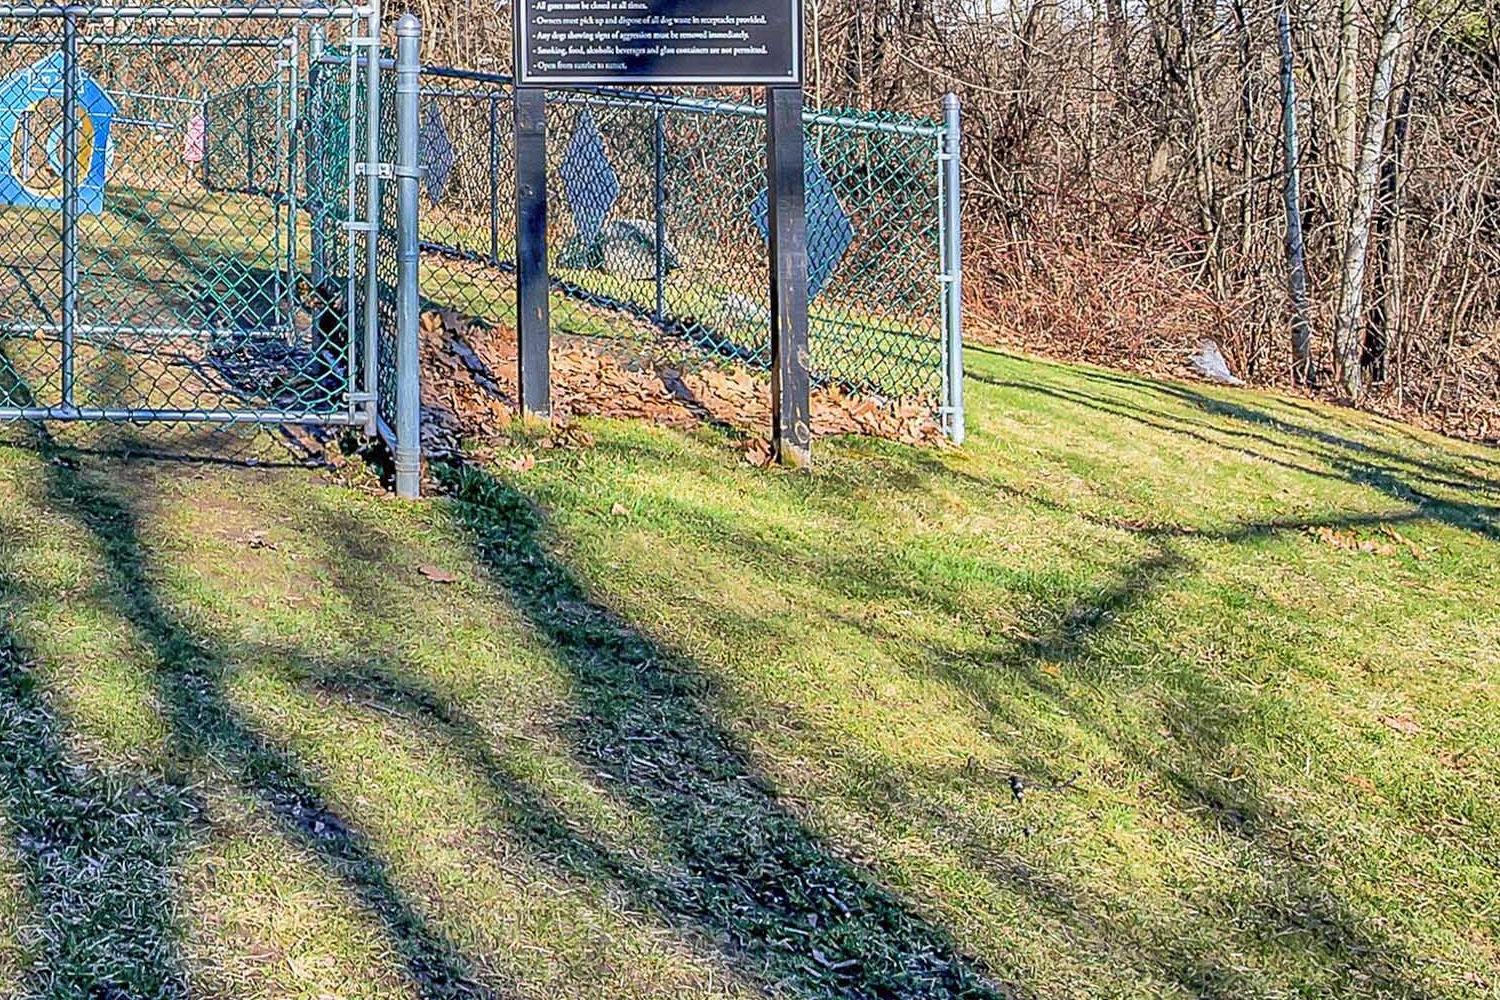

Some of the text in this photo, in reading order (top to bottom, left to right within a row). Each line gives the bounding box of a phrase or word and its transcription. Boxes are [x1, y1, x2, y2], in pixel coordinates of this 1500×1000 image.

[536, 1, 546, 10] All
[581, 1, 589, 10] be
[590, 1, 610, 10] closed
[618, 1, 627, 9] all
[627, 1, 648, 10] times.
[536, 16, 562, 25] Owners
[562, 17, 579, 25] must
[579, 16, 594, 26] pick
[595, 18, 604, 26] up
[605, 16, 617, 24] and
[618, 16, 642, 26] dispose
[642, 15, 651, 24] of
[651, 16, 659, 24] all
[660, 15, 673, 26] dog
[692, 15, 700, 24] in
[700, 15, 735, 26] receptacles
[735, 15, 768, 26] provided.
[536, 31, 551, 41] Any
[551, 30, 566, 41] dogs
[567, 30, 594, 41] showing
[595, 31, 610, 41] signs
[611, 30, 620, 39] of
[620, 31, 652, 41] aggression
[670, 30, 679, 39] be
[679, 30, 708, 39] removed
[537, 46, 568, 56] Smoking,
[568, 45, 586, 55] food,
[586, 45, 615, 54] alcoholic
[615, 45, 646, 56] beverages
[646, 45, 659, 54] and
[660, 45, 675, 56] glass
[675, 45, 709, 54] containers
[733, 45, 768, 56] permitted.
[537, 61, 556, 71] Open
[557, 60, 573, 69] from
